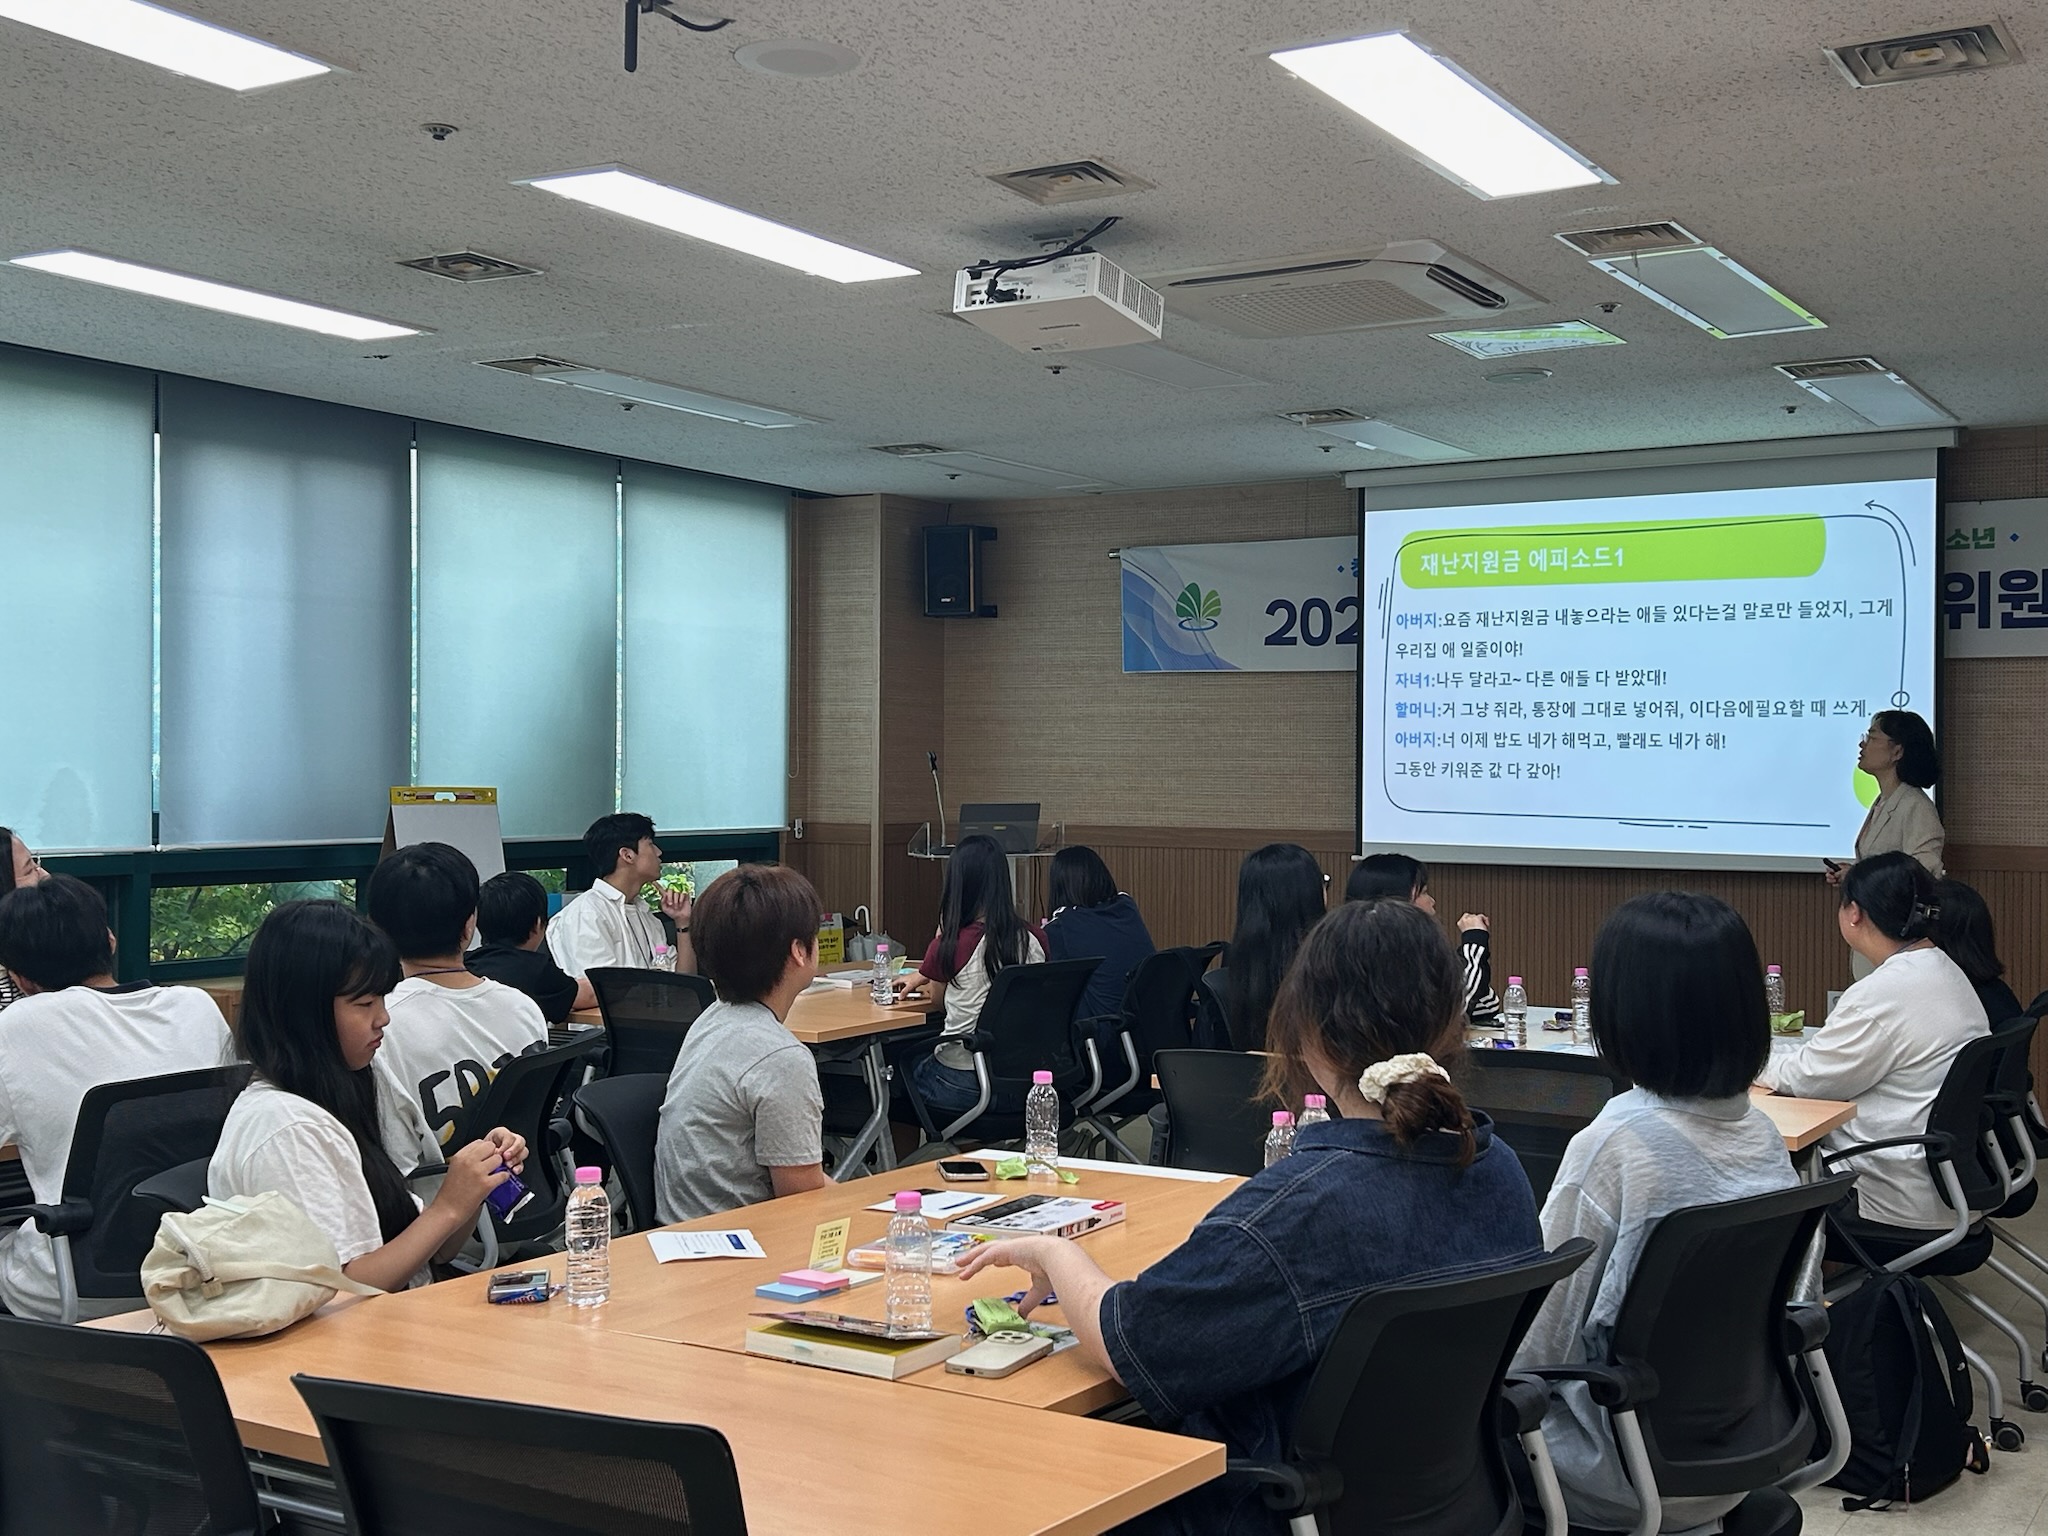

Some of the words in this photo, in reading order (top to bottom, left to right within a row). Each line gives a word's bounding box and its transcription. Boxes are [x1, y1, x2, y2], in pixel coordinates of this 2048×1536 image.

[1420, 549, 1521, 576] 재난지원금
[1528, 547, 1623, 572] 에피소드1
[1396, 612, 1471, 629] 아버지:요즘
[1476, 610, 1549, 627] 재난지원금
[1556, 607, 1631, 625] 내놓으라는
[1637, 606, 1667, 623] 애들
[1674, 604, 1735, 622] 있다는걸
[1743, 602, 1792, 620] 말로만
[1798, 600, 1853, 619] 들었지,
[1859, 599, 1892, 616] 그게
[1396, 642, 1436, 659] 우리집
[1442, 642, 1454, 658] 애
[1461, 641, 1522, 657] 일줄이야!
[1470, 672, 1521, 687] 달라고~
[1527, 671, 1555, 687] 다른
[1561, 670, 1590, 687] 애들
[1596, 670, 1610, 687] 다
[1616, 669, 1666, 686] 받았대!
[1396, 702, 1454, 718] 할머니:거
[1461, 702, 1489, 717] 그냥
[1494, 701, 1526, 719] 줘라,
[1532, 701, 1575, 718] 통장에
[1582, 701, 1627, 717] 그대로
[1634, 701, 1683, 719] 넣어줘,
[1811, 700, 1825, 717] 때
[1395, 732, 1454, 748] 아버지:너
[1461, 732, 1487, 748] 이제
[1494, 732, 1522, 748] 밥도
[1528, 732, 1557, 749] 네가
[1562, 732, 1611, 750] 해먹고,
[1617, 733, 1663, 749] 빨래도
[1670, 732, 1700, 750] 네가
[1706, 733, 1725, 750] 해!
[1395, 762, 1436, 777] 그동안
[1442, 762, 1483, 778] 키워준
[1489, 762, 1502, 778] 값
[1508, 763, 1521, 779] 다
[1527, 763, 1560, 780] 갚아!
